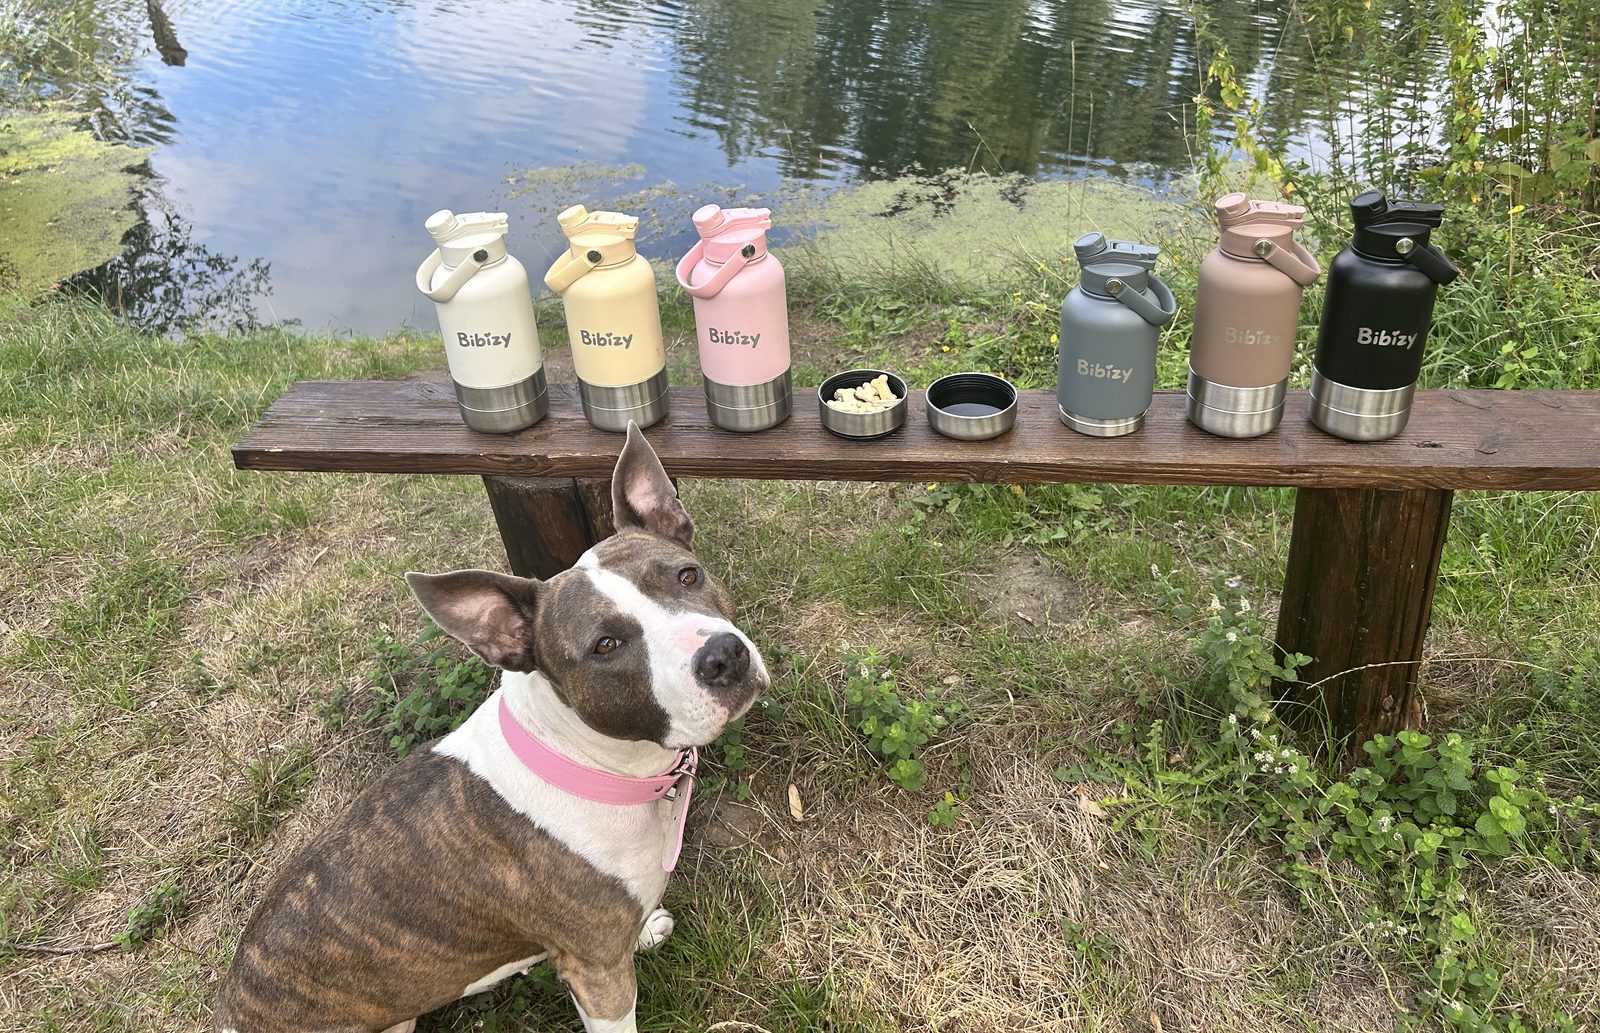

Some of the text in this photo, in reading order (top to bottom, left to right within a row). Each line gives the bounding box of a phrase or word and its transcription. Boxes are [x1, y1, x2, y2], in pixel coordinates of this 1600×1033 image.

[457, 332, 512, 348] Bibizy
[580, 330, 633, 349] Bibizy
[708, 328, 761, 349] Bibizy
[1356, 327, 1418, 350] Bibizy
[1077, 359, 1133, 384] Bibizy
